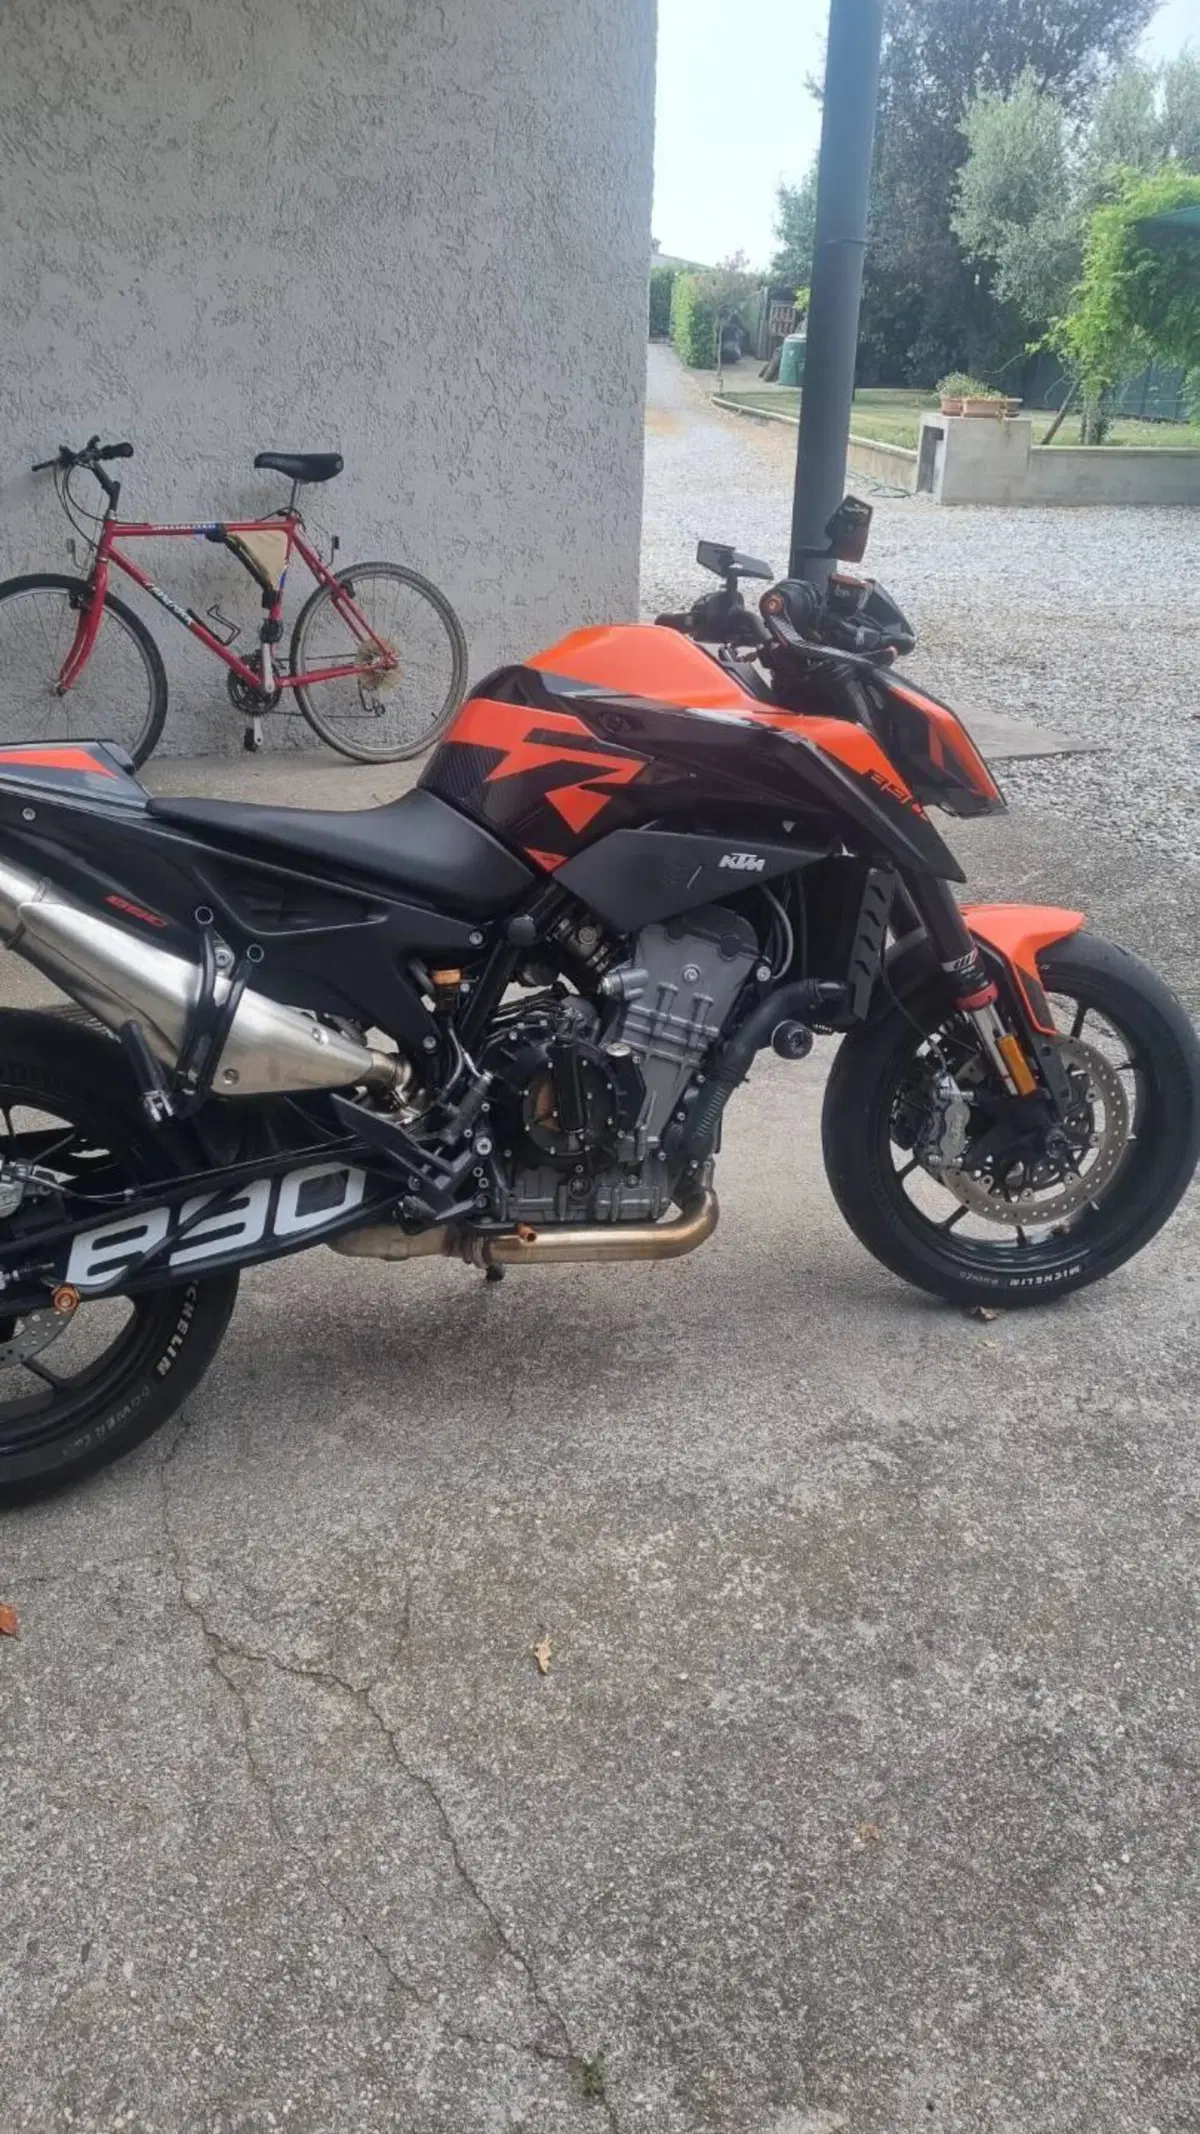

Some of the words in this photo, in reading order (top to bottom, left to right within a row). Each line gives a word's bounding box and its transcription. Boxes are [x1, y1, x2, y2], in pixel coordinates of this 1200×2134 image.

[717, 852, 766, 872] KTM
[65, 1161, 367, 1287] 890
[156, 1280, 199, 1376] CHELIN
